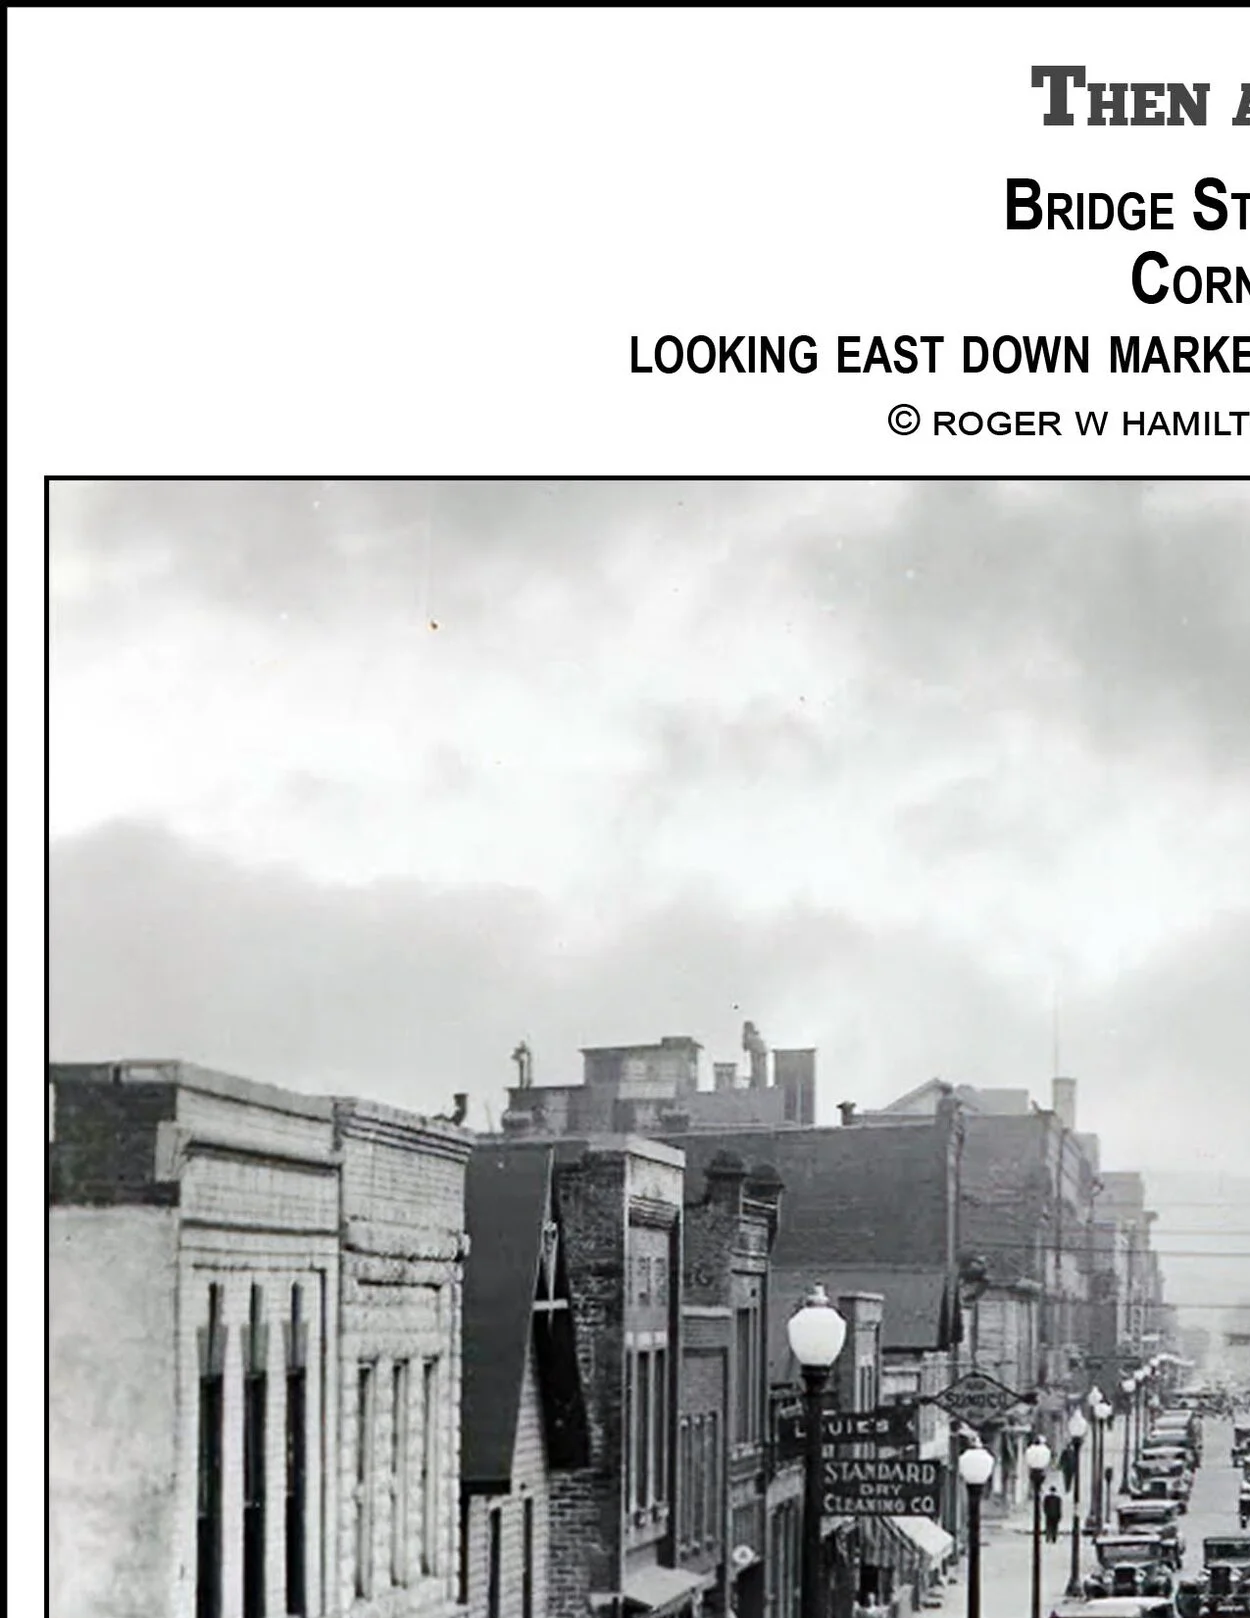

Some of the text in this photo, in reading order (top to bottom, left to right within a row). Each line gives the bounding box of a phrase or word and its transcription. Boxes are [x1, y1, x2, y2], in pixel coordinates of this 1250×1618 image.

[945, 1391, 1008, 1409] SUNOCO
[795, 1419, 889, 1439] LUIE'S
[824, 1461, 936, 1485] STANDARD
[860, 1483, 902, 1496] DRY
[823, 1494, 906, 1513] CLEANING
